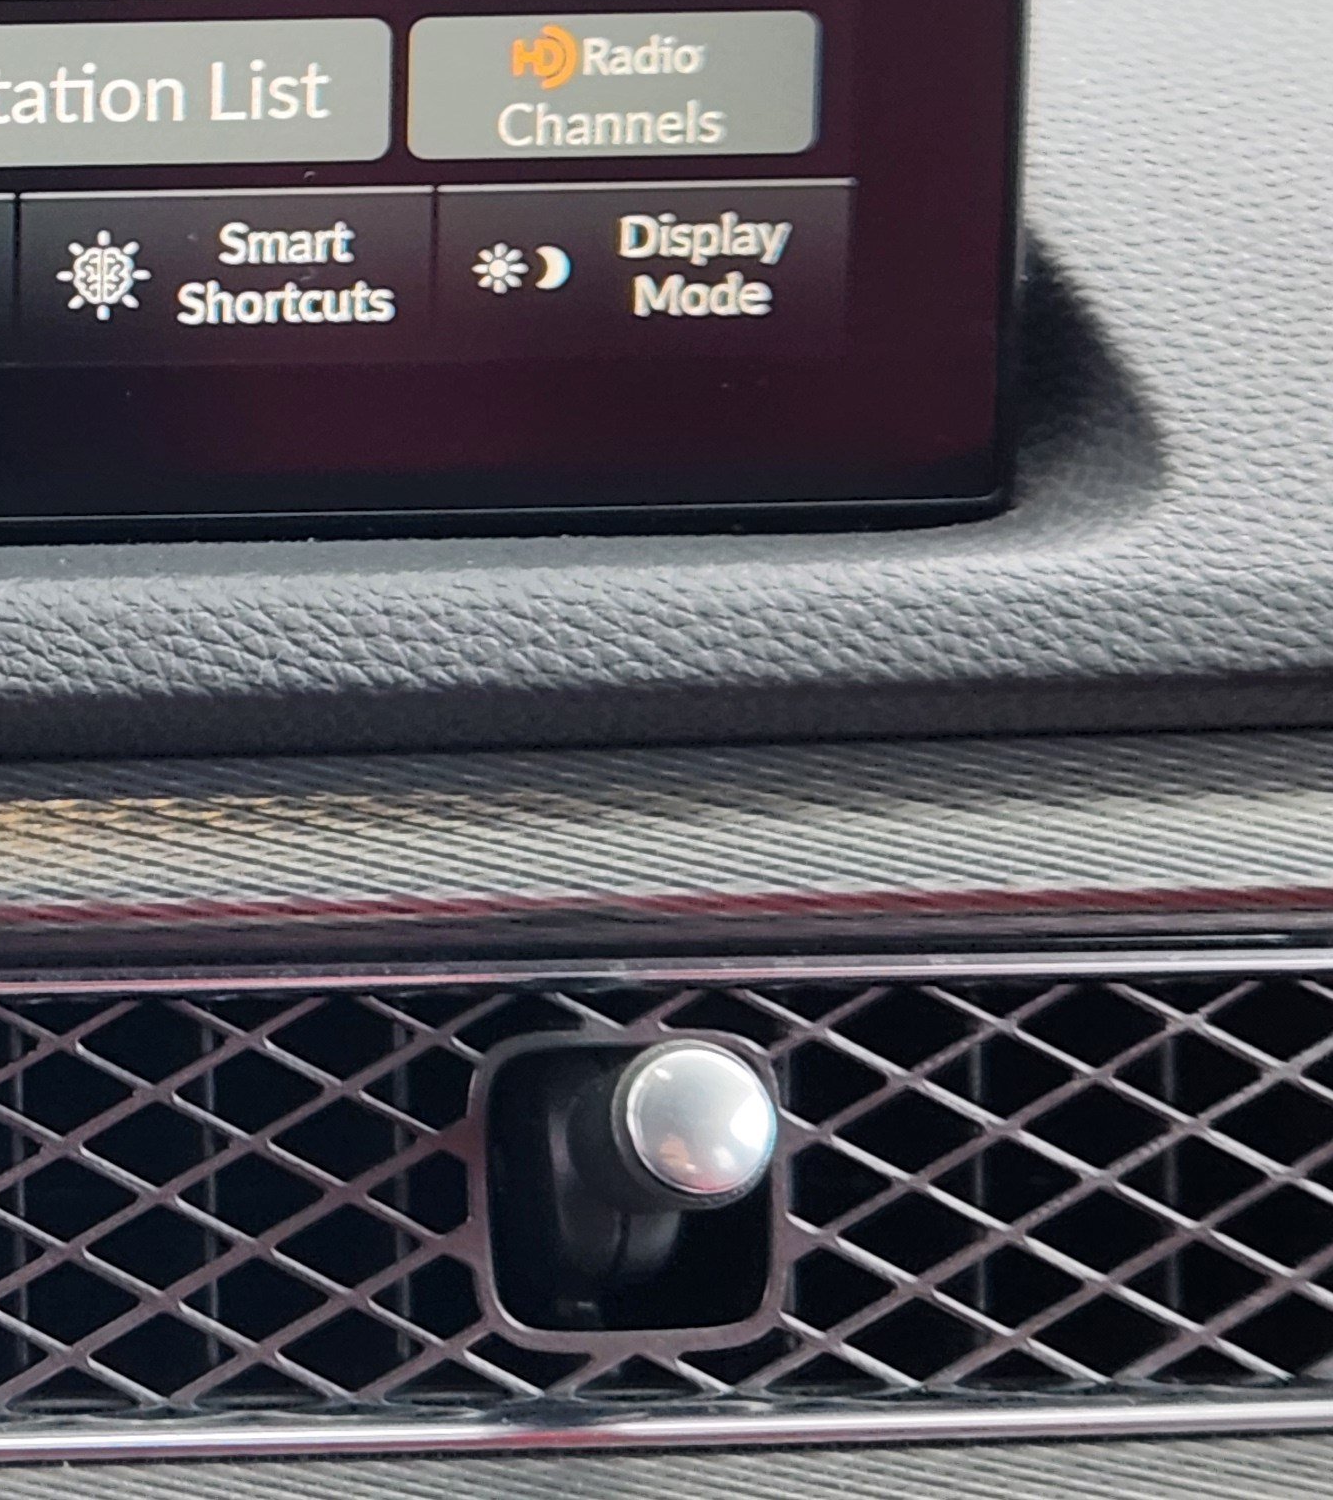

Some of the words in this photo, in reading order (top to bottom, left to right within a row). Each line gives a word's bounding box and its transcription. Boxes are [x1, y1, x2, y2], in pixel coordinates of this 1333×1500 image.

[581, 34, 705, 80] Radio
[209, 58, 331, 122] List
[497, 100, 727, 148] Channels
[217, 221, 355, 268] Smart
[617, 214, 793, 268] Display
[175, 282, 397, 328] Shortcuts
[633, 274, 775, 320] Mode
